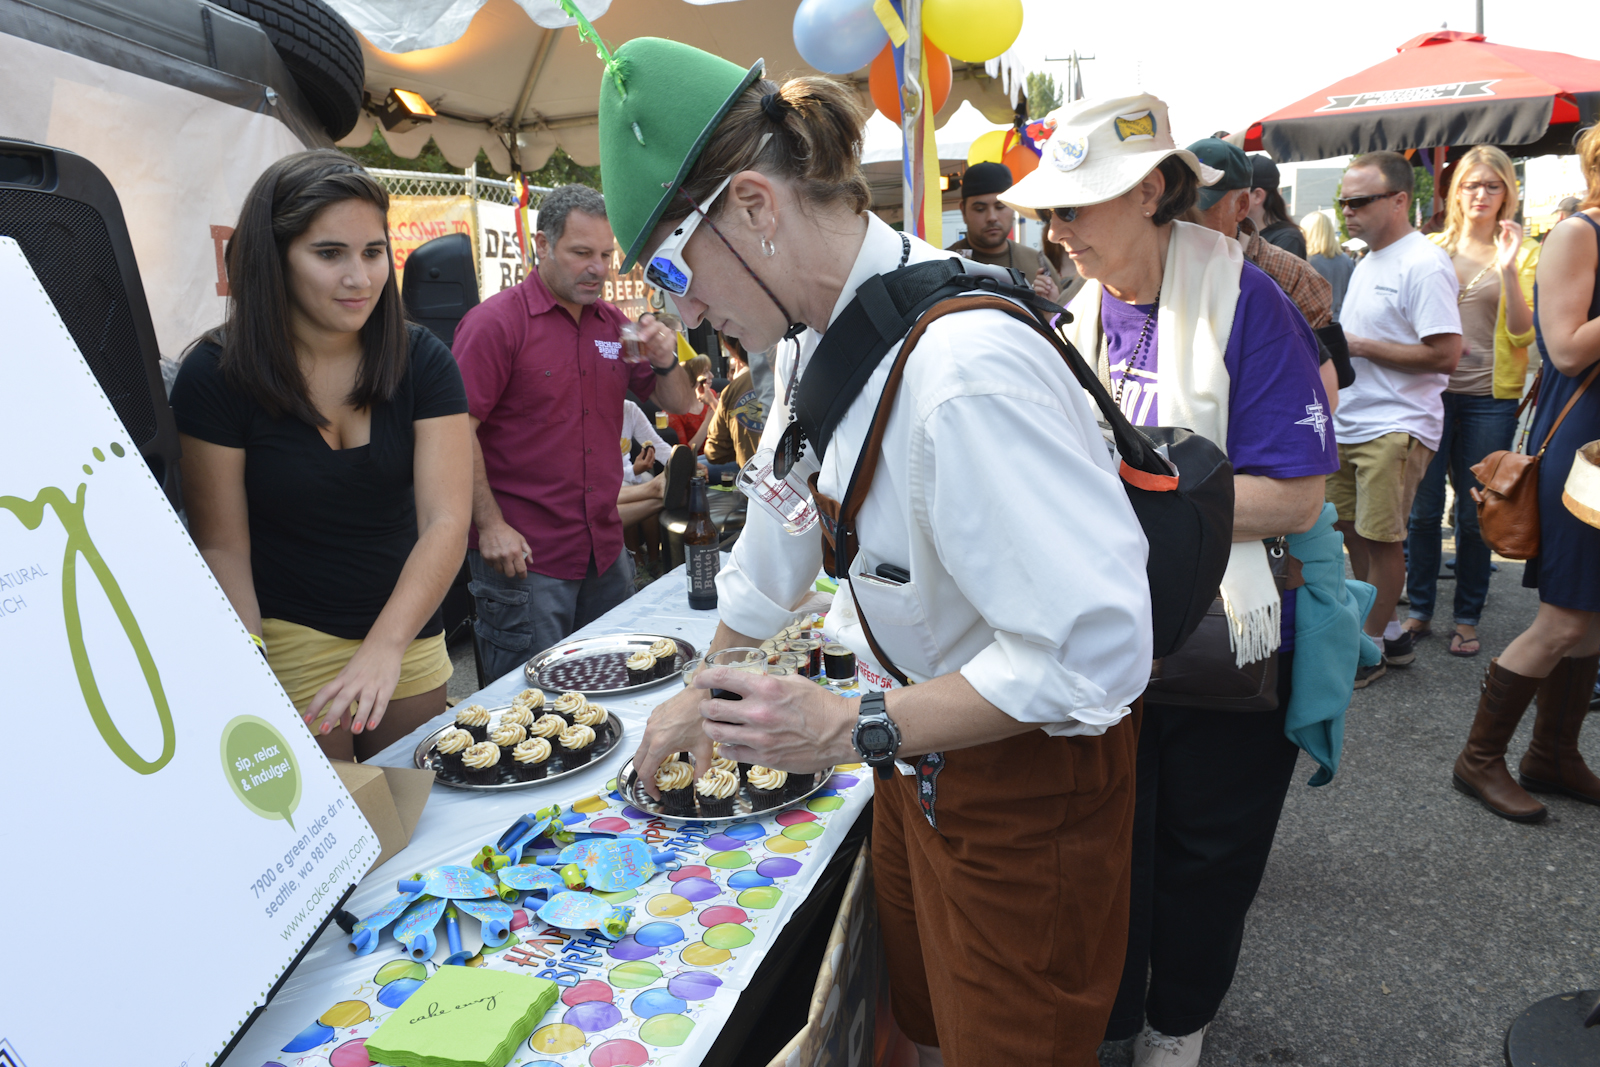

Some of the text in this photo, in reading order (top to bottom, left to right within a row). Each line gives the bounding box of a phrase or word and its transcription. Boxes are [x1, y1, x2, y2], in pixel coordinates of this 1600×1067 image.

[388, 220, 471, 241] LCOME TO
[604, 280, 645, 301] BEER
[621, 306, 645, 319] ATICS
[0, 563, 49, 592] ATURAL
[694, 554, 703, 590] Black
[704, 553, 713, 589] Butte
[880, 675, 893, 689] 5K
[235, 745, 281, 772] sip, relax
[241, 758, 291, 791] & indulge!
[250, 798, 345, 899] 7900 e green lake dr n
[265, 832, 337, 918] seattle, wa 98103
[280, 835, 369, 941] www.cake-envy.com
[409, 990, 504, 1025] cake envy
